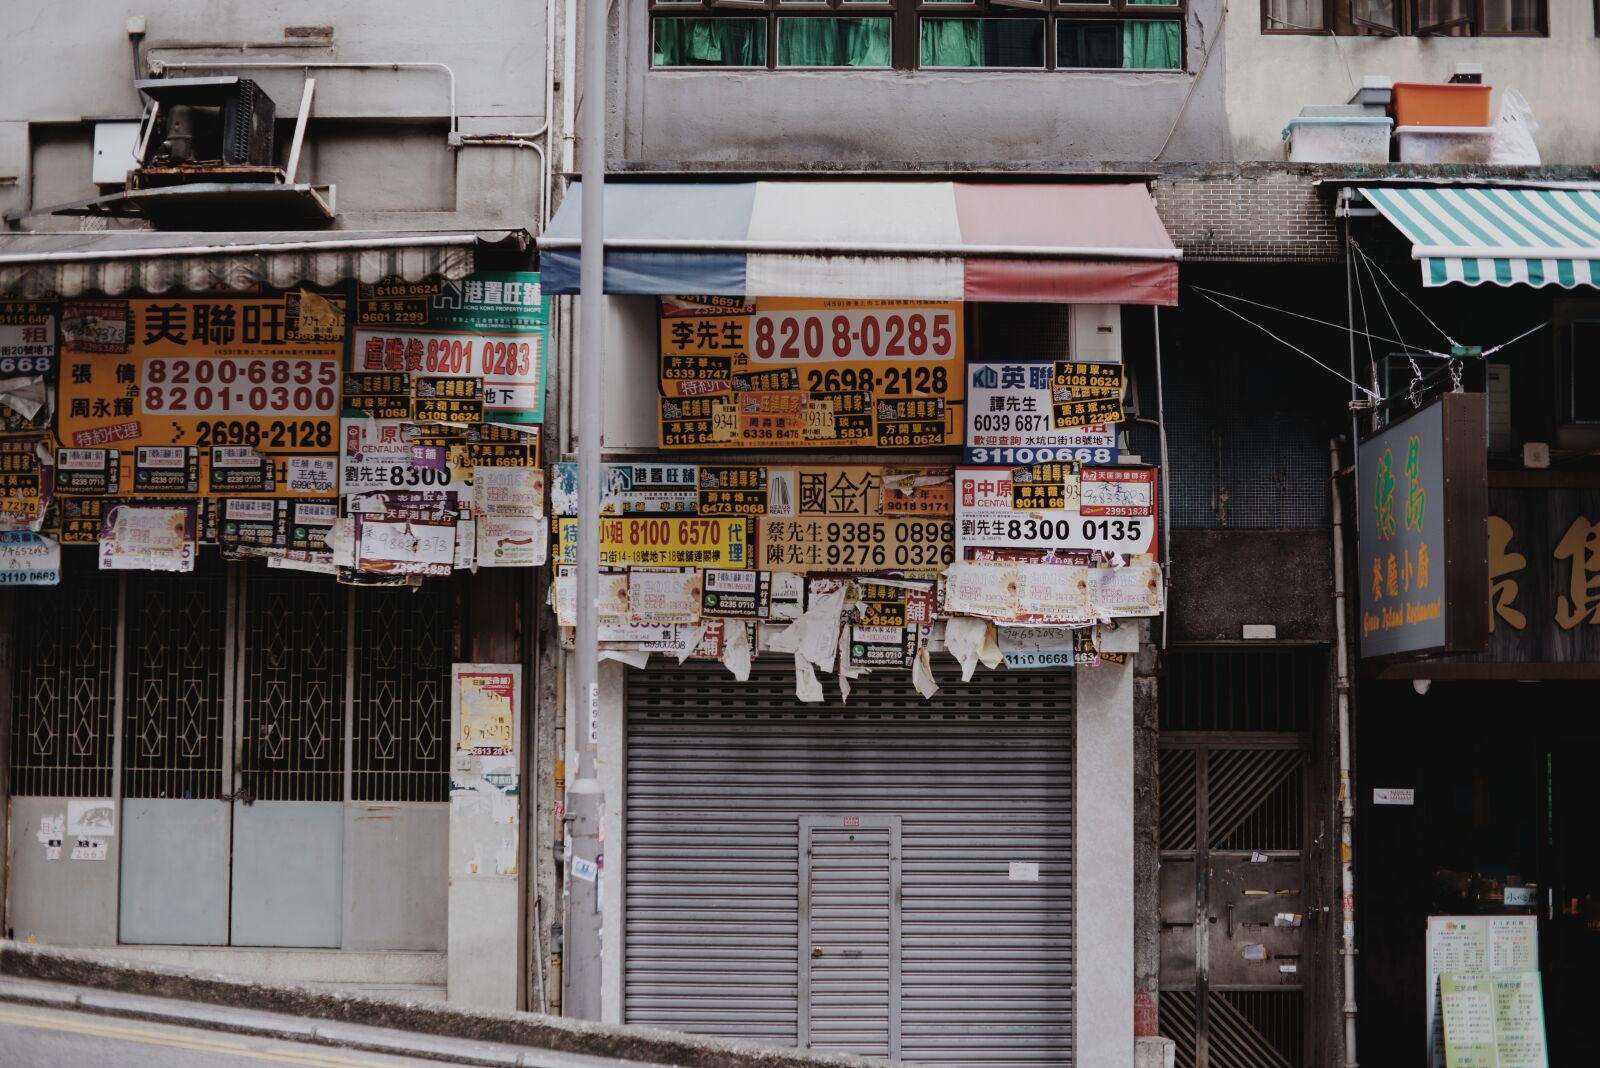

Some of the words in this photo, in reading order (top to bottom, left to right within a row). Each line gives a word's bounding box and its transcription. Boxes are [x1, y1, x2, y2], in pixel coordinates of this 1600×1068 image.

[144, 303, 340, 346] 美聯旺
[362, 313, 391, 323] 9601
[394, 312, 424, 322] 2299
[22, 327, 48, 343] 租
[671, 320, 744, 350] 李先生
[426, 338, 473, 374] 8201
[481, 340, 531, 376] 0283
[733, 352, 748, 366] 洽
[665, 368, 696, 379] 6339
[698, 368, 729, 379] 8747
[1057, 375, 1087, 385] 6108
[1090, 377, 1120, 387] 0624
[126, 384, 141, 397] 洽
[70, 397, 135, 419] 周永輝
[989, 396, 1037, 412] 譚先生
[378, 408, 408, 419] 1068
[450, 410, 480, 422] 0624
[808, 411, 834, 428] 9313
[1056, 415, 1086, 427] 9601
[1089, 411, 1121, 424] 2299
[713, 414, 737, 430] 9341
[974, 414, 1010, 432] 6039
[1015, 414, 1050, 432] 6871
[74, 422, 142, 448] 特約代理
[665, 434, 696, 445] 5115
[743, 429, 773, 439] 6336
[840, 428, 872, 439] 5831
[880, 435, 911, 446] 6108
[913, 433, 943, 445] 0624
[973, 435, 1022, 446] 歡迎查詢
[1025, 435, 1114, 446] 水坑口街18號地下
[463, 458, 492, 467] 9011
[971, 448, 1112, 464] 31100668
[298, 469, 327, 481] 王先生
[345, 465, 389, 483] 劉先生
[701, 502, 732, 513] 6473
[734, 503, 765, 514] 0068
[887, 501, 917, 512] 9018
[919, 501, 950, 512] 9171
[1016, 498, 1047, 508] 9011
[1105, 507, 1127, 516] 2395
[1128, 507, 1149, 516] 1828
[629, 519, 671, 545] 8100
[678, 519, 721, 545] 6570
[767, 521, 824, 543] 蔡先生
[826, 522, 886, 543] 9385
[894, 522, 955, 544] 0898
[961, 519, 1006, 537] 劉先生
[1007, 519, 1070, 541] 8300
[1082, 520, 1141, 541] 0135
[727, 523, 743, 562] 代理
[766, 544, 823, 565] 陳先生
[826, 544, 886, 566] 9276
[894, 544, 955, 566] 0326
[719, 601, 737, 609] 6235
[738, 601, 755, 609] 0710
[1382, 601, 1404, 632] Island
[1406, 595, 1441, 626] Restaurant
[1038, 653, 1069, 665] 0668
